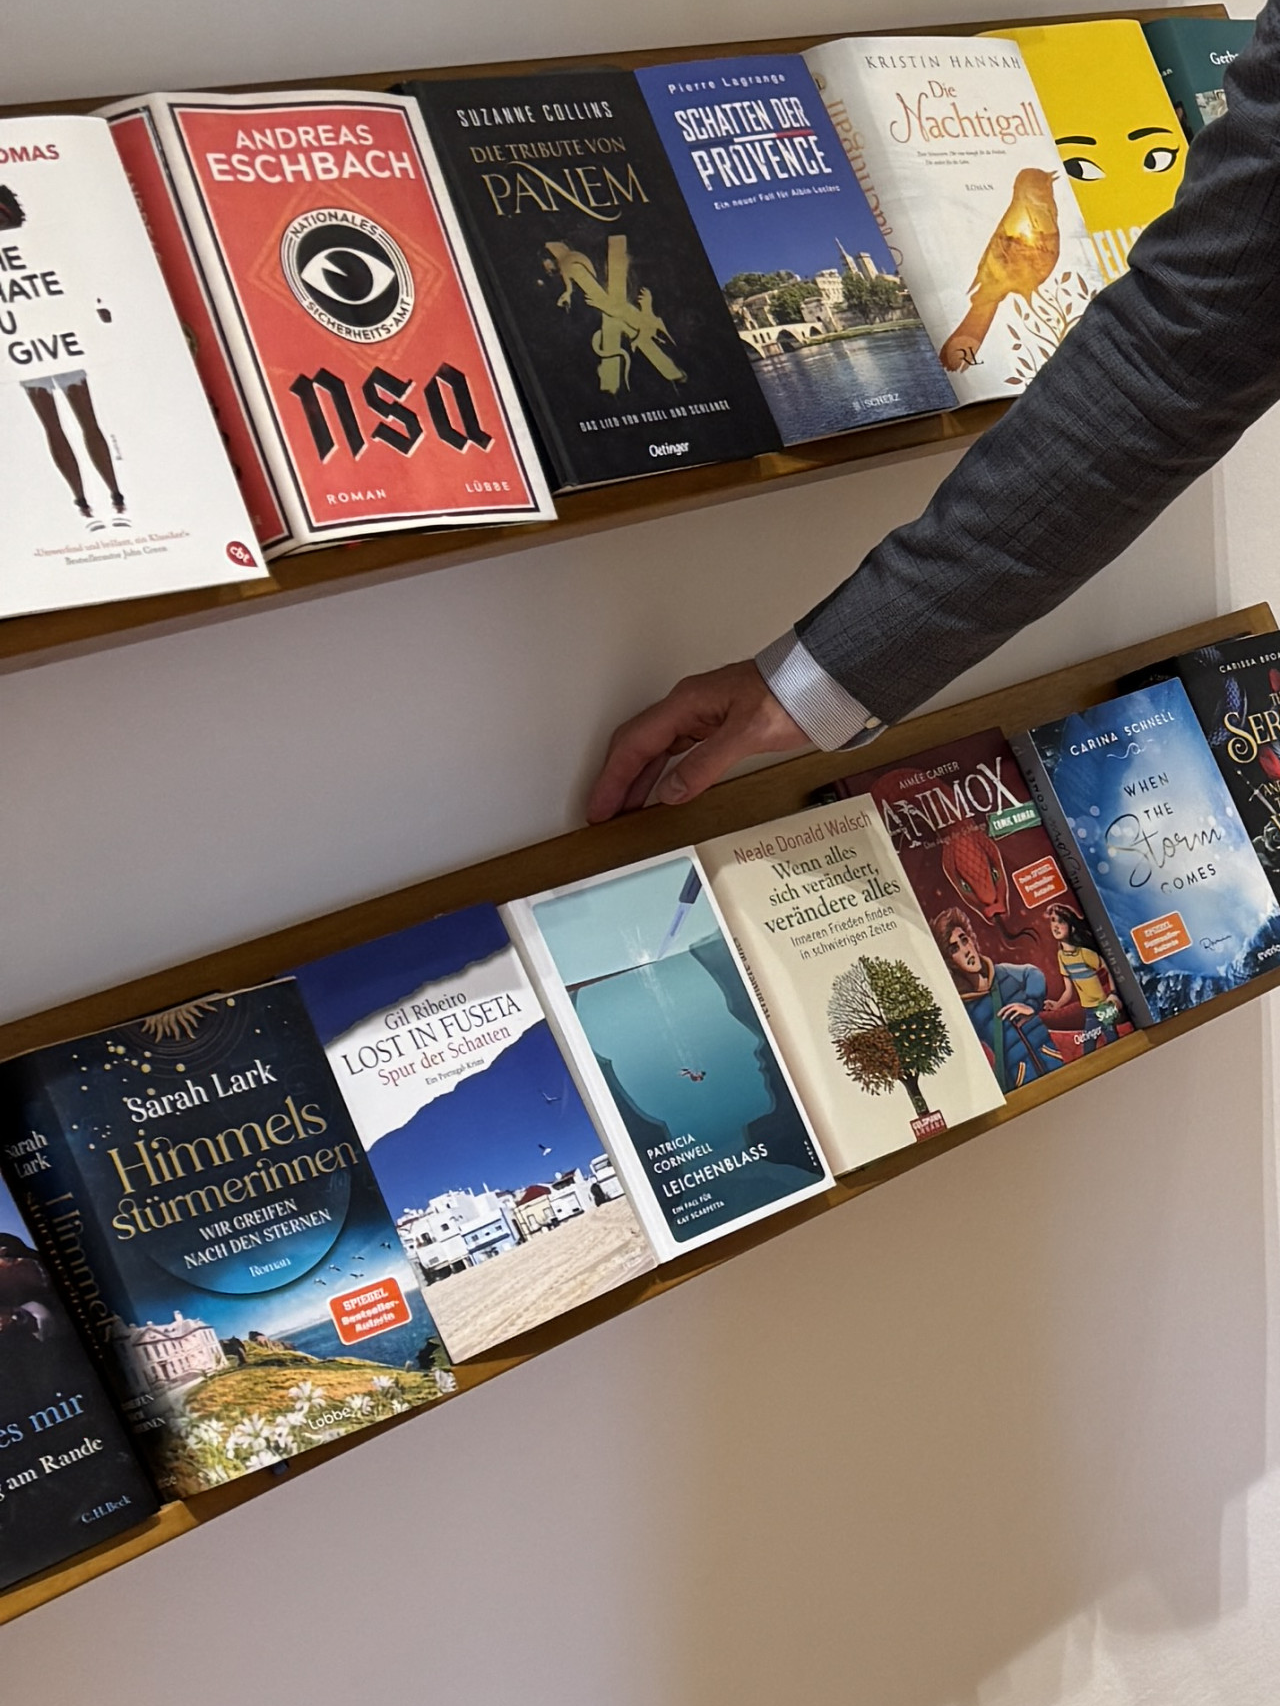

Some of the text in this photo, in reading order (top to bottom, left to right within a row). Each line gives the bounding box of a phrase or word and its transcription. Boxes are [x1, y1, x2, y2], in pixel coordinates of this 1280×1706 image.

[865, 56, 1021, 69] KRISTIN HANNAH
[668, 74, 786, 94] Pierre Lagrange
[928, 80, 958, 98] Die
[456, 101, 613, 127] SUZANNE COLLINS
[674, 97, 811, 143] SCHATTEN DER
[890, 92, 1045, 144] Nachtigall
[236, 124, 374, 150] ANDREAS
[470, 136, 626, 163] DIE TRIBUTE VON
[205, 150, 416, 183] ESCHBACH
[691, 136, 832, 191] PROVENCE
[481, 160, 650, 221] PANEM
[714, 201, 730, 210] Ein
[732, 197, 757, 207] neuer
[760, 192, 775, 202] Fall
[777, 189, 790, 199] für
[290, 210, 380, 240] NATIONALES
[306, 299, 413, 341] SICHERHEITS-AMT
[8, 332, 85, 365] GIVE
[290, 362, 495, 465] nsa
[579, 400, 730, 432] DAS LIED VON VOGEL UND SCHLANGE
[864, 393, 900, 408] SCHERZ
[649, 442, 689, 457] Oetinger
[326, 489, 387, 505] ROMAN
[465, 480, 511, 493] LÜBBE
[229, 545, 251, 563] cbt
[1219, 658, 1257, 674] CARISSA
[1070, 711, 1175, 756] CARINA SCHNELL
[899, 761, 960, 790] AIMÉE CARTER
[1124, 772, 1169, 797] WHEN
[881, 756, 1024, 849] ANIMOX
[1144, 802, 1173, 819] THE
[733, 811, 873, 865] Neale Donald Walsch
[1105, 813, 1222, 888] Storm
[771, 845, 858, 880] Wenn alles
[1161, 863, 1217, 894] COMES
[769, 861, 880, 907] sich verändert,
[764, 877, 901, 934] verändere alles
[790, 905, 895, 948] Inneren Frieden finden
[799, 920, 898, 960] in schwierigen Zeiten
[384, 992, 467, 1031] Gil Ribeiro
[341, 992, 522, 1076] LOST IN FUSETA
[377, 1025, 512, 1087] Spur der Schatten
[126, 1059, 278, 1123] Sarah Lark
[425, 1076, 438, 1085] Ein
[107, 1095, 329, 1195] Himmels
[646, 1133, 696, 1160] PATRICIA
[653, 1142, 713, 1174] CORNWELL
[661, 1143, 769, 1198] LEICHENBLASS
[112, 1141, 360, 1241] stürmerinnen
[672, 1193, 713, 1215] EIN FALL FÜR
[199, 1198, 298, 1241] WIR GREIFEN
[690, 1200, 725, 1220] SCARPETTA
[184, 1208, 332, 1271] NACH DEN STERNEN
[249, 1258, 292, 1278] Roman
[342, 1288, 389, 1312] SPIEGEL
[28, 1392, 84, 1433] mir
[6, 1437, 104, 1490] am Rande
[81, 1495, 132, 1524] C.H.Beck
